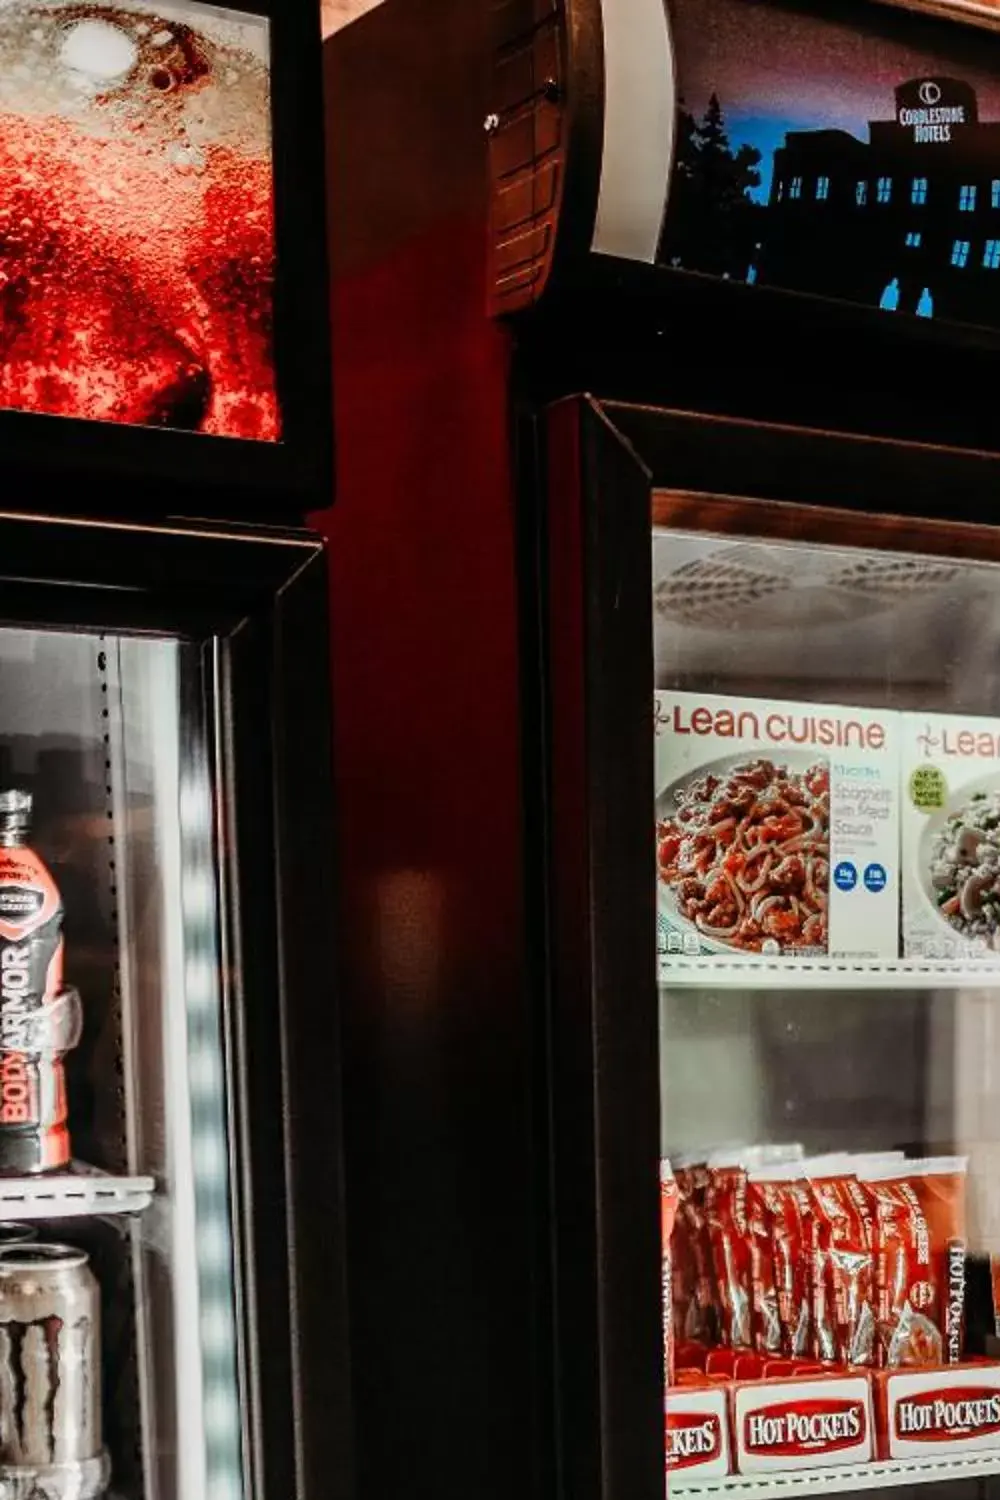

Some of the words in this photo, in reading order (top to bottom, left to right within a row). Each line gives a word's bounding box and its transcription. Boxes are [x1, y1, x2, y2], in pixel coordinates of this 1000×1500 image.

[914, 124, 951, 143] HOTELS
[673, 705, 760, 739] Lean
[749, 1415, 785, 1446] HOT
[785, 1406, 860, 1442] POCKETS
[900, 1402, 933, 1431] HOT
[666, 1419, 716, 1456] KETS
